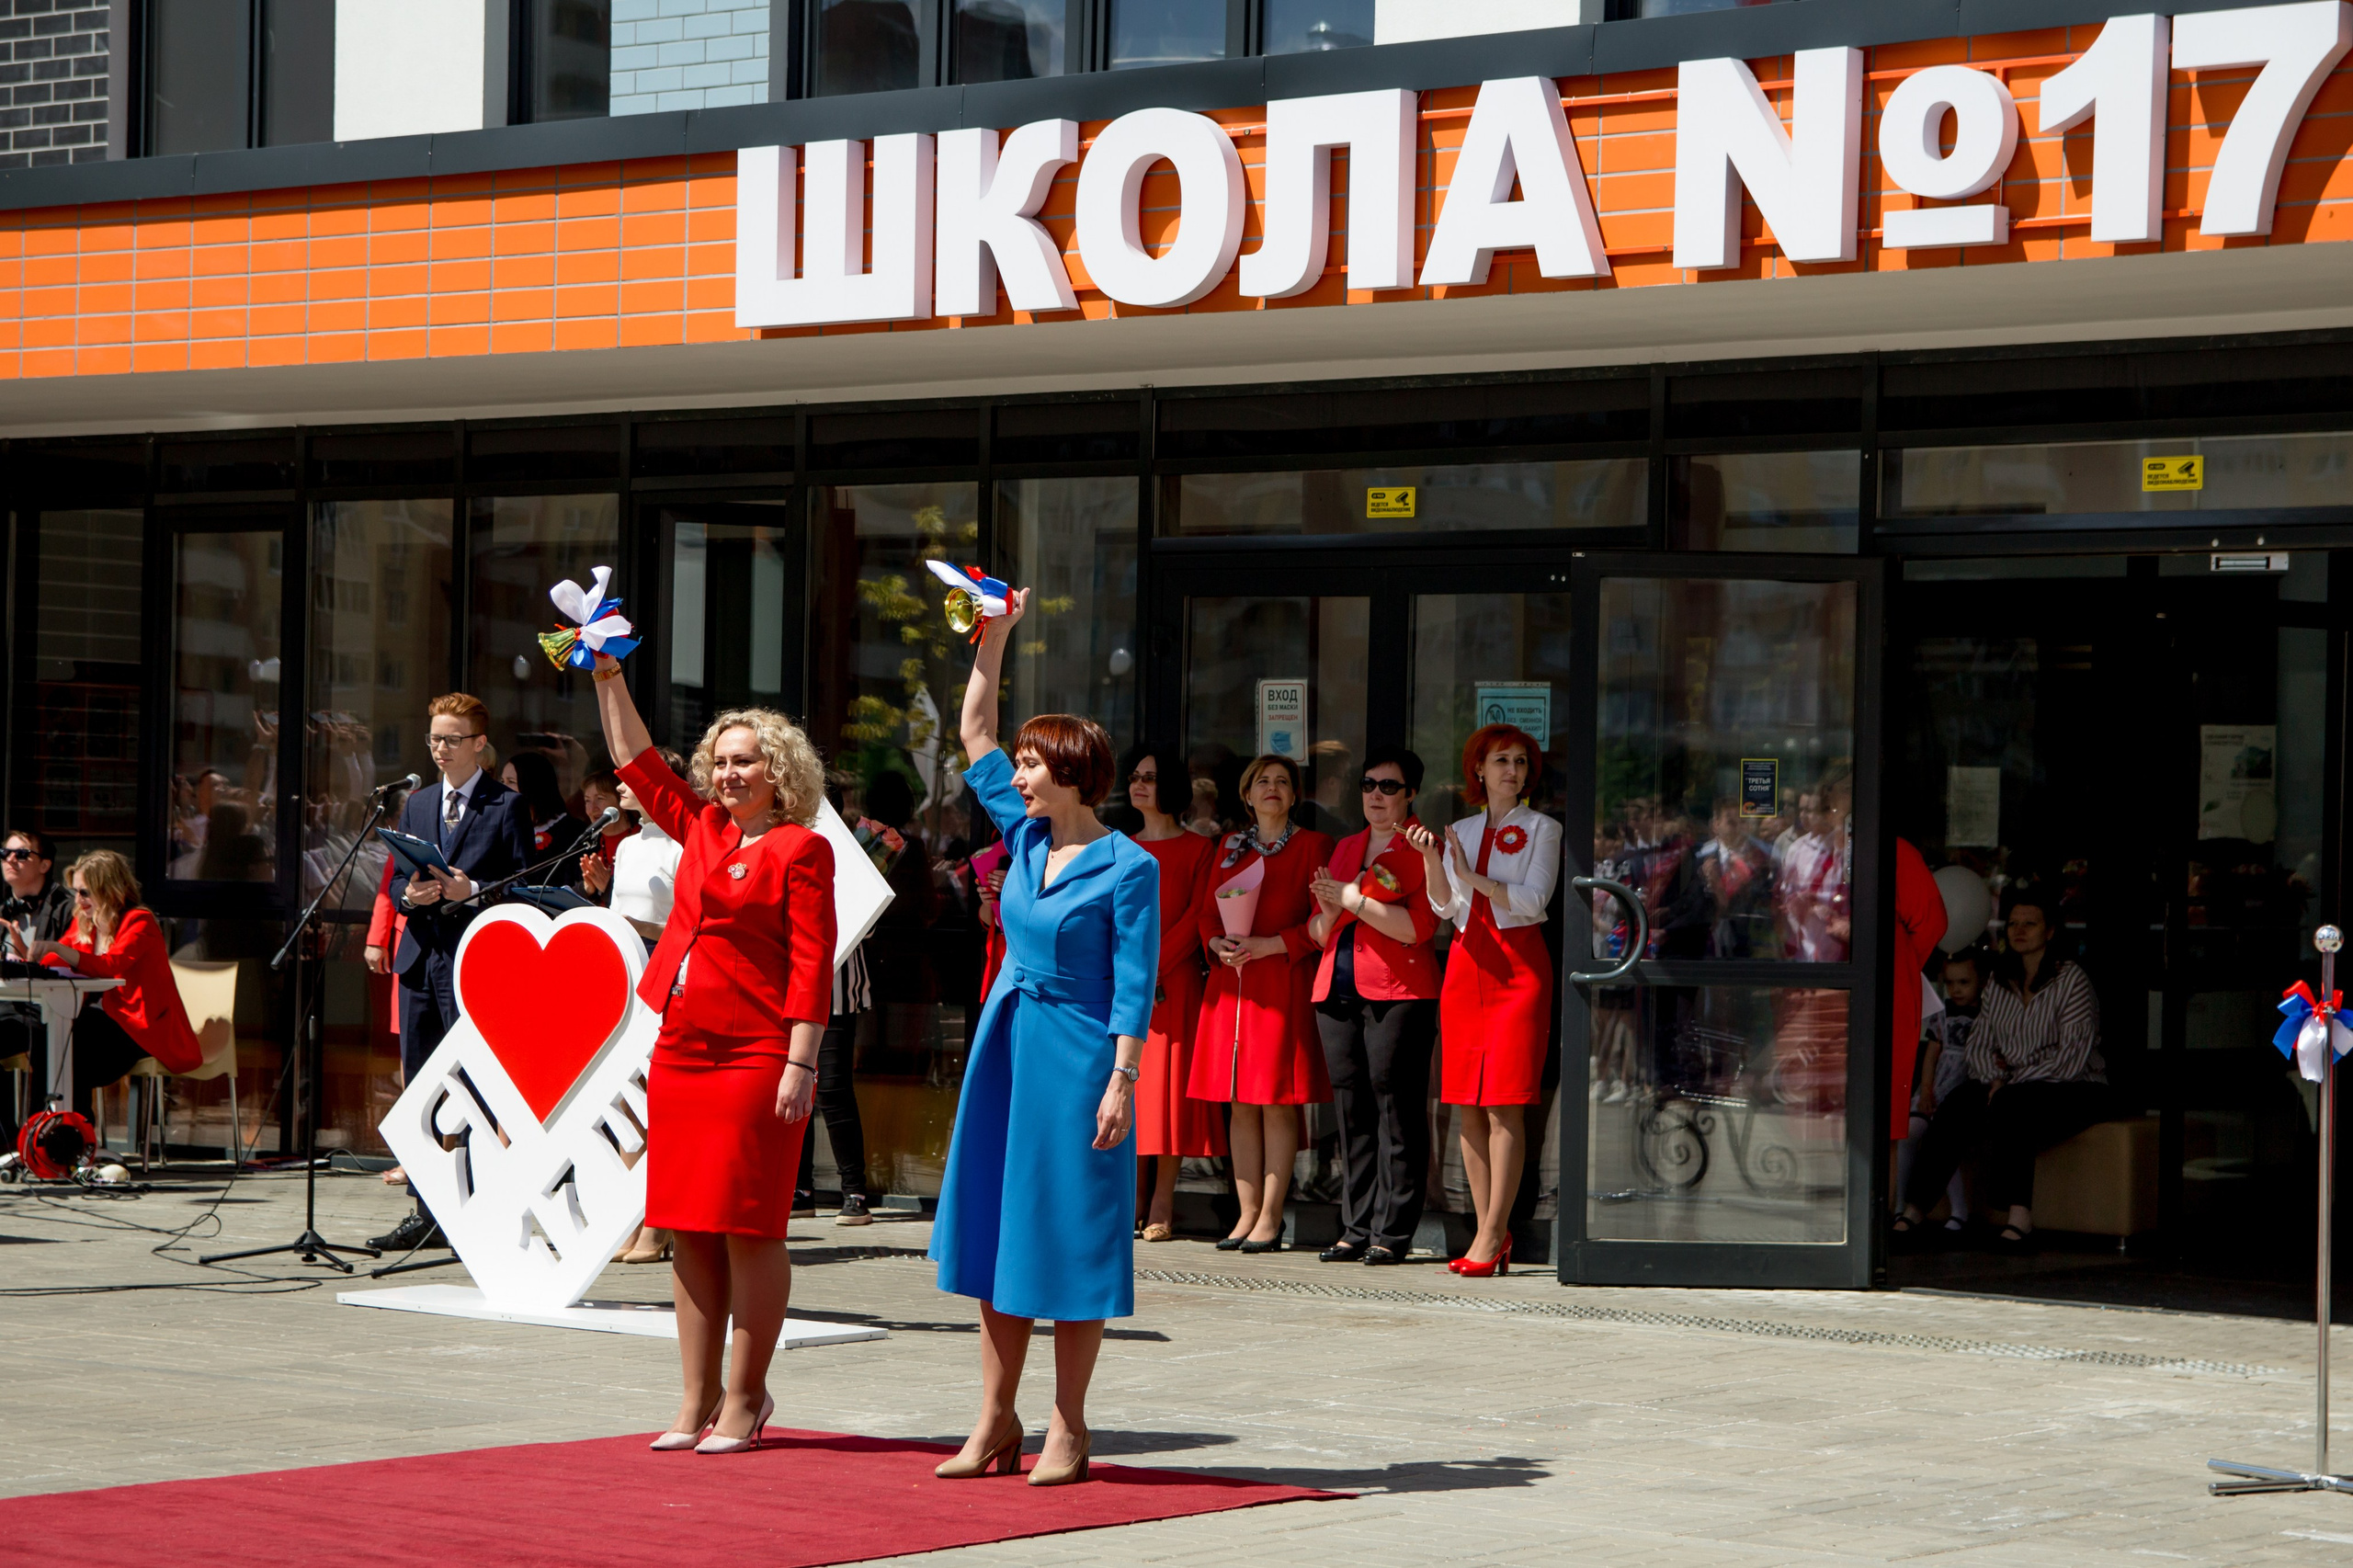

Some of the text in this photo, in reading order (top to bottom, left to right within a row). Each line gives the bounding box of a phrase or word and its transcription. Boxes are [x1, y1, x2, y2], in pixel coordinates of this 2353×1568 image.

[735, 0, 2353, 329] ШКОЛА №17
[1267, 689, 1298, 703] ВХОД
[518, 1157, 589, 1267] 17
